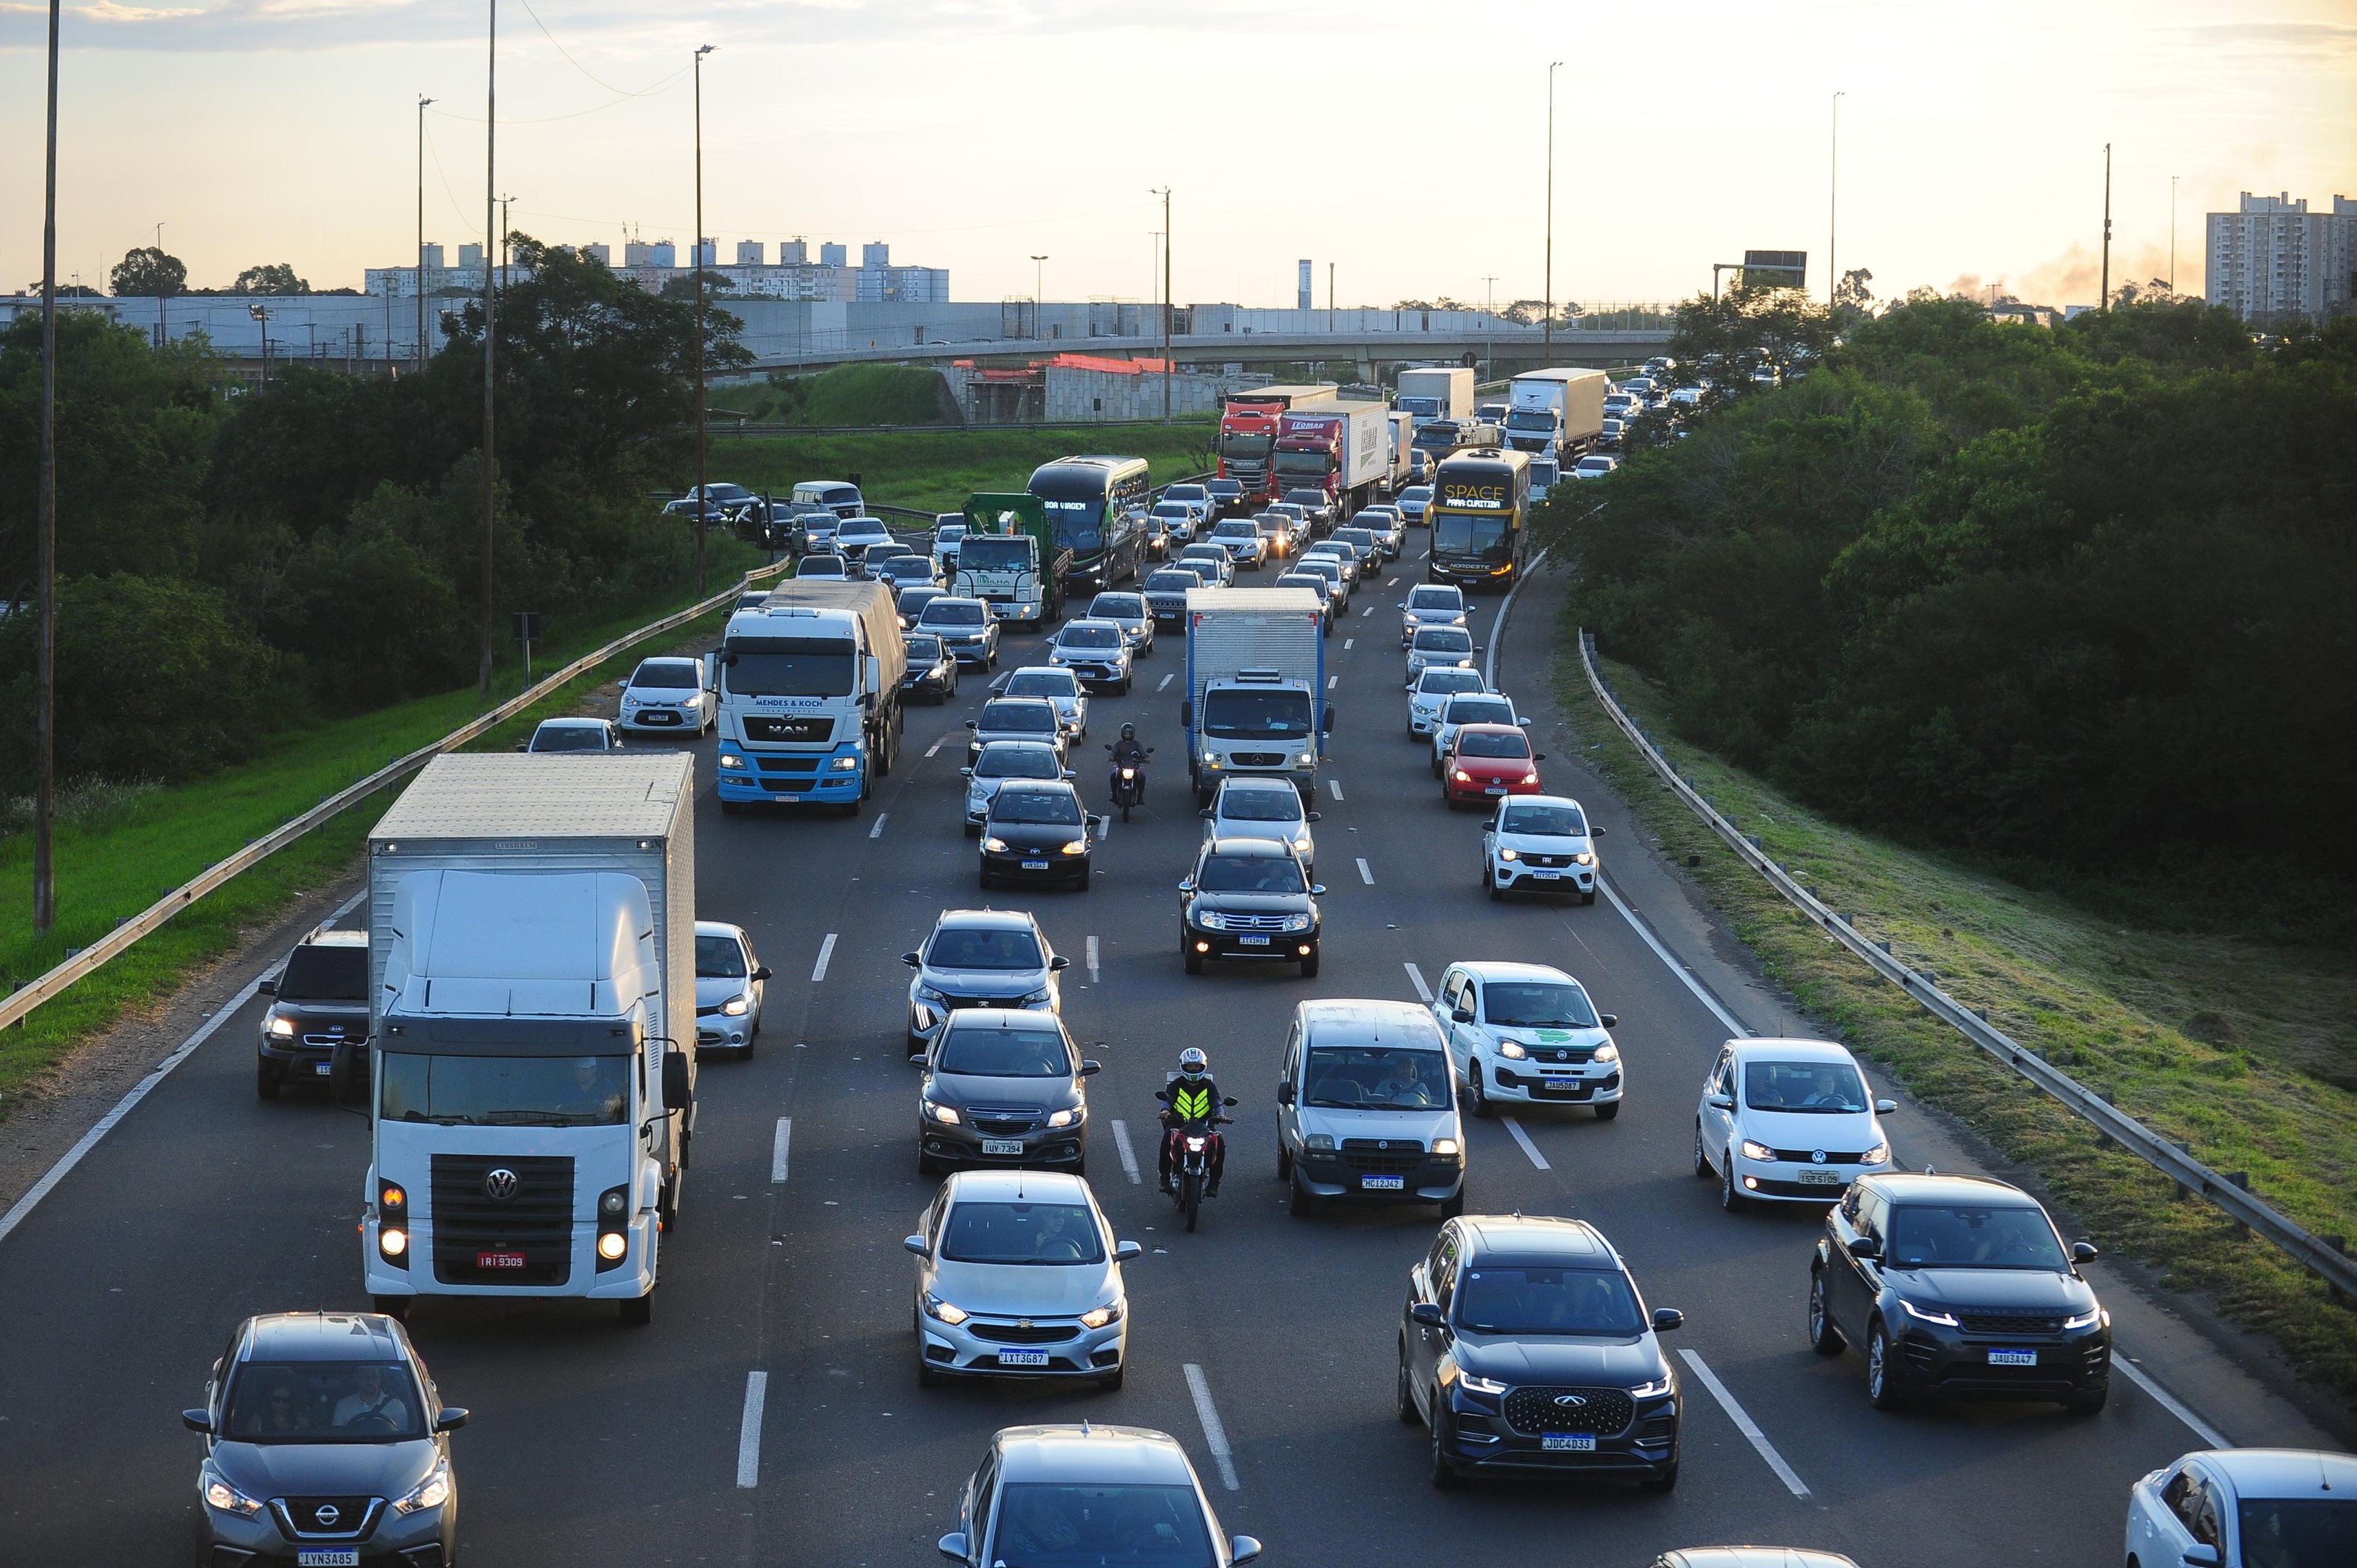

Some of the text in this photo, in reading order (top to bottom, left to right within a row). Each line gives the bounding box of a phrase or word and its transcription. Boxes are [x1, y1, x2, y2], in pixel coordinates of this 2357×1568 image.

[1291, 421, 1325, 430] LEOMAR
[1444, 484, 1506, 501] SPACE
[1060, 502, 1086, 510] VIAGEM
[1466, 499, 1500, 508] CURITIBA
[1003, 1354, 1044, 1364] IXT3G87
[1993, 1355, 2032, 1365] JAU3A47
[1547, 1439, 1590, 1450] JDC4D33
[305, 1553, 352, 1565] IYN3A85
